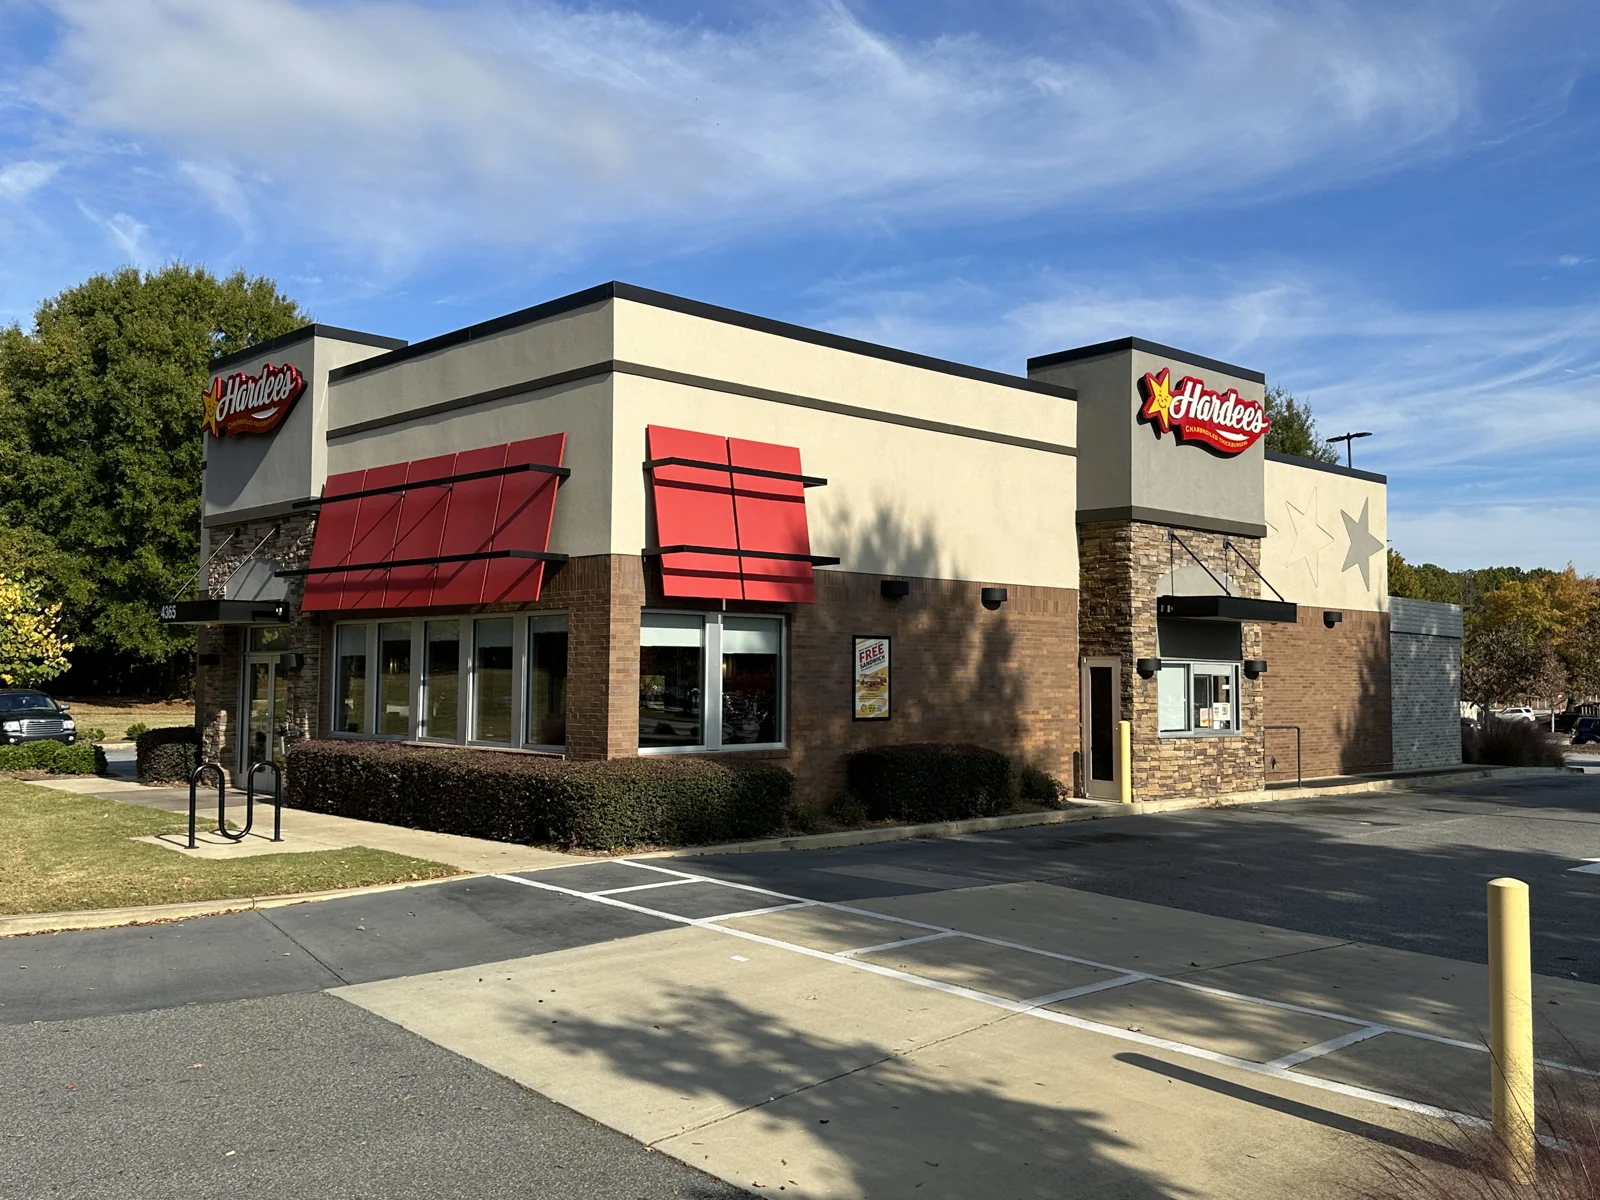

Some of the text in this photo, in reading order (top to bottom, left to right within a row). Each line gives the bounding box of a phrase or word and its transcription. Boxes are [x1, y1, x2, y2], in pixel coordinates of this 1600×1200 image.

[216, 366, 296, 421] Hardee's
[1169, 381, 1269, 433] Hardee's
[161, 605, 177, 619] 4365
[859, 643, 885, 663] FREE
[860, 655, 886, 670] SANDWICH
